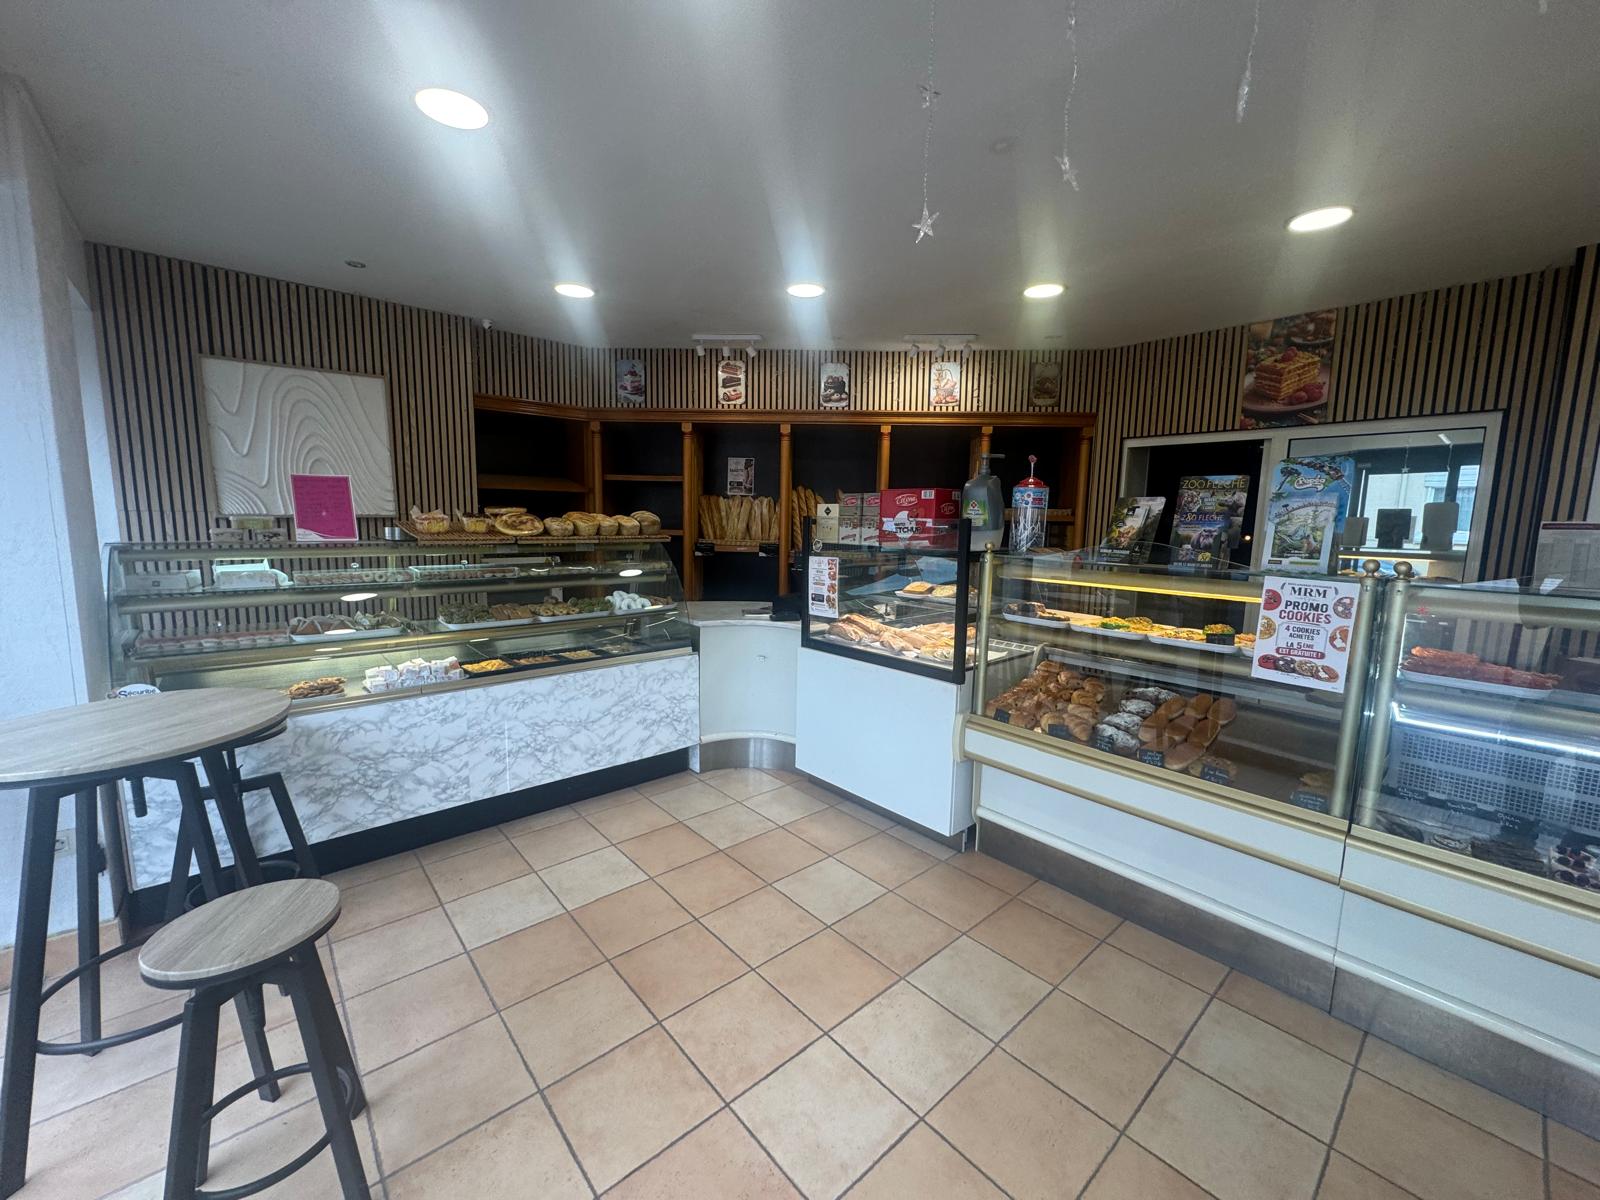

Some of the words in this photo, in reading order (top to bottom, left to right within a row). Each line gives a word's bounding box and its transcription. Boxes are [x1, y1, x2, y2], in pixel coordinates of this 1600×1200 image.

[1290, 587, 1328, 599] MRM
[1284, 600, 1329, 613] PROMO
[1278, 609, 1332, 625] COOKIES
[1292, 626, 1321, 636] COOKIES
[1290, 649, 1318, 658] GRATUITE
